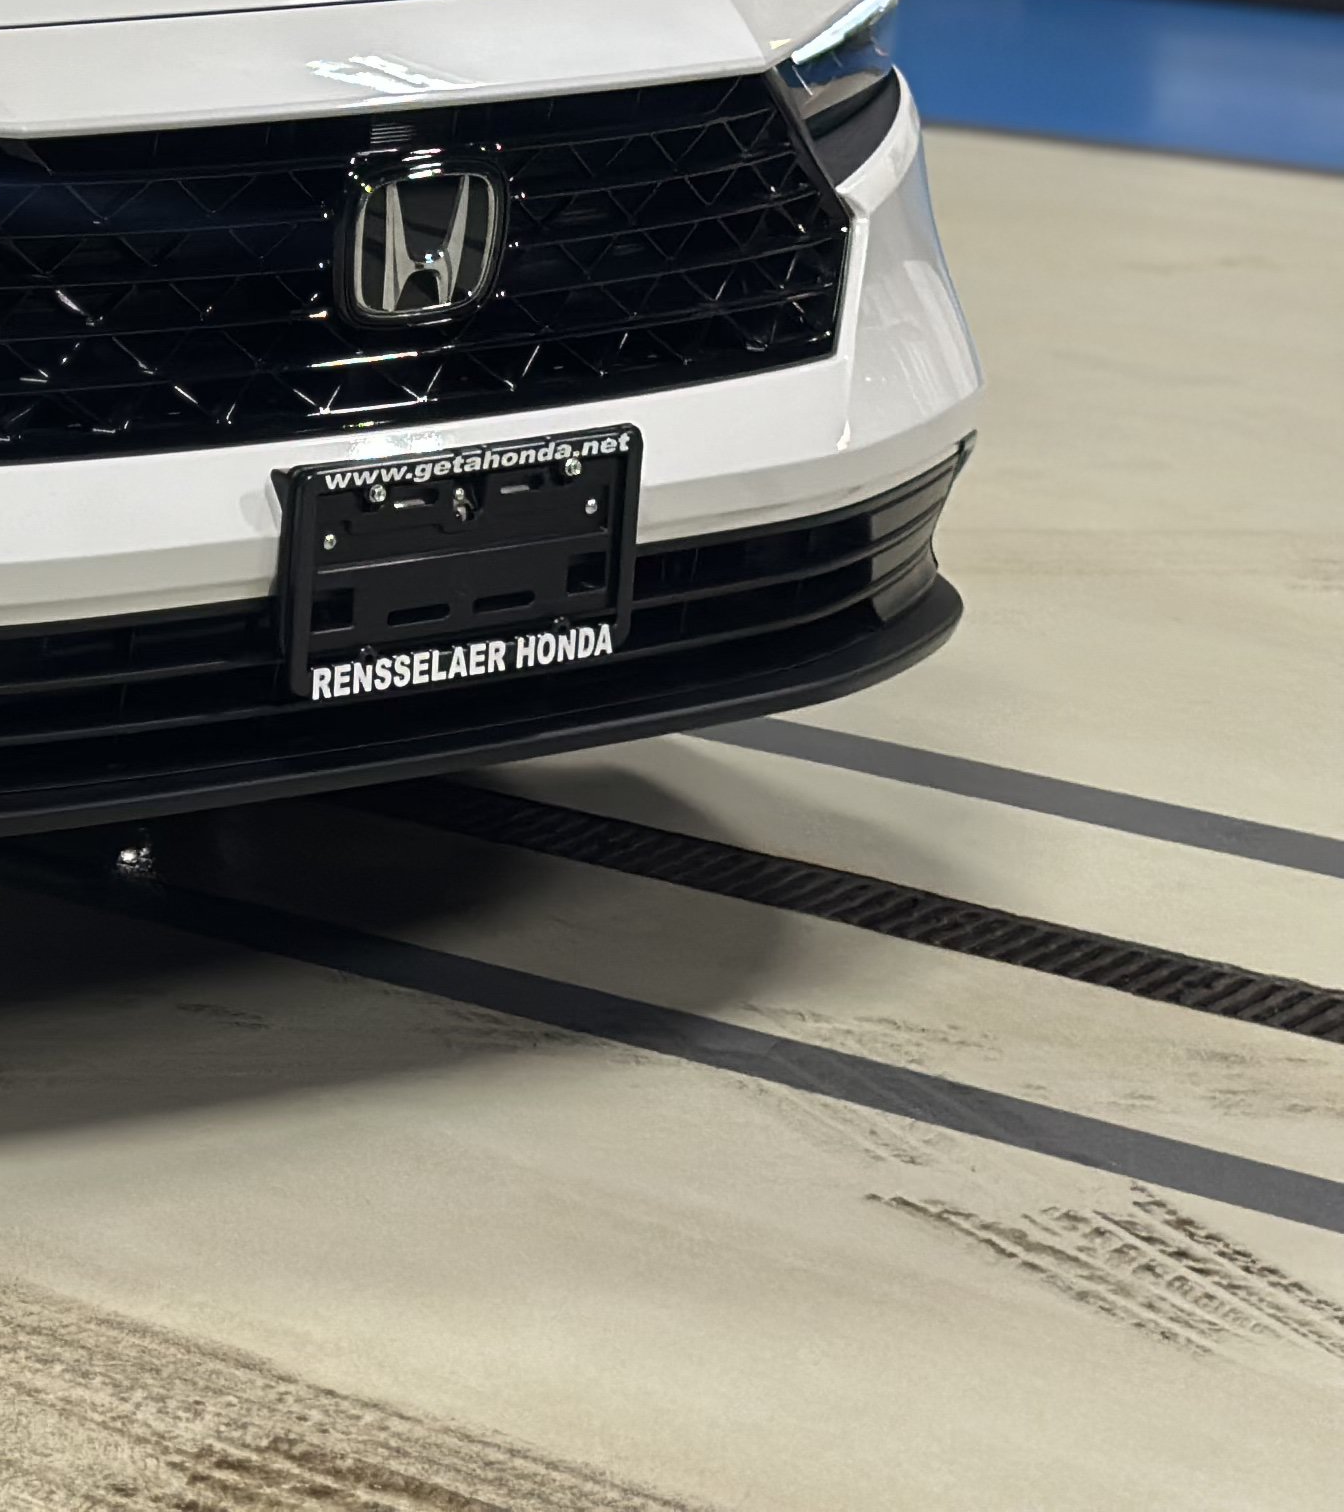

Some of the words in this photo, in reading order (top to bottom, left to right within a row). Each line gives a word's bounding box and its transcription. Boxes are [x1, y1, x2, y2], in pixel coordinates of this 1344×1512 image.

[325, 433, 630, 489] www.getahonda.net
[312, 640, 506, 700] RENSSELAER
[515, 623, 612, 668] HONDA
